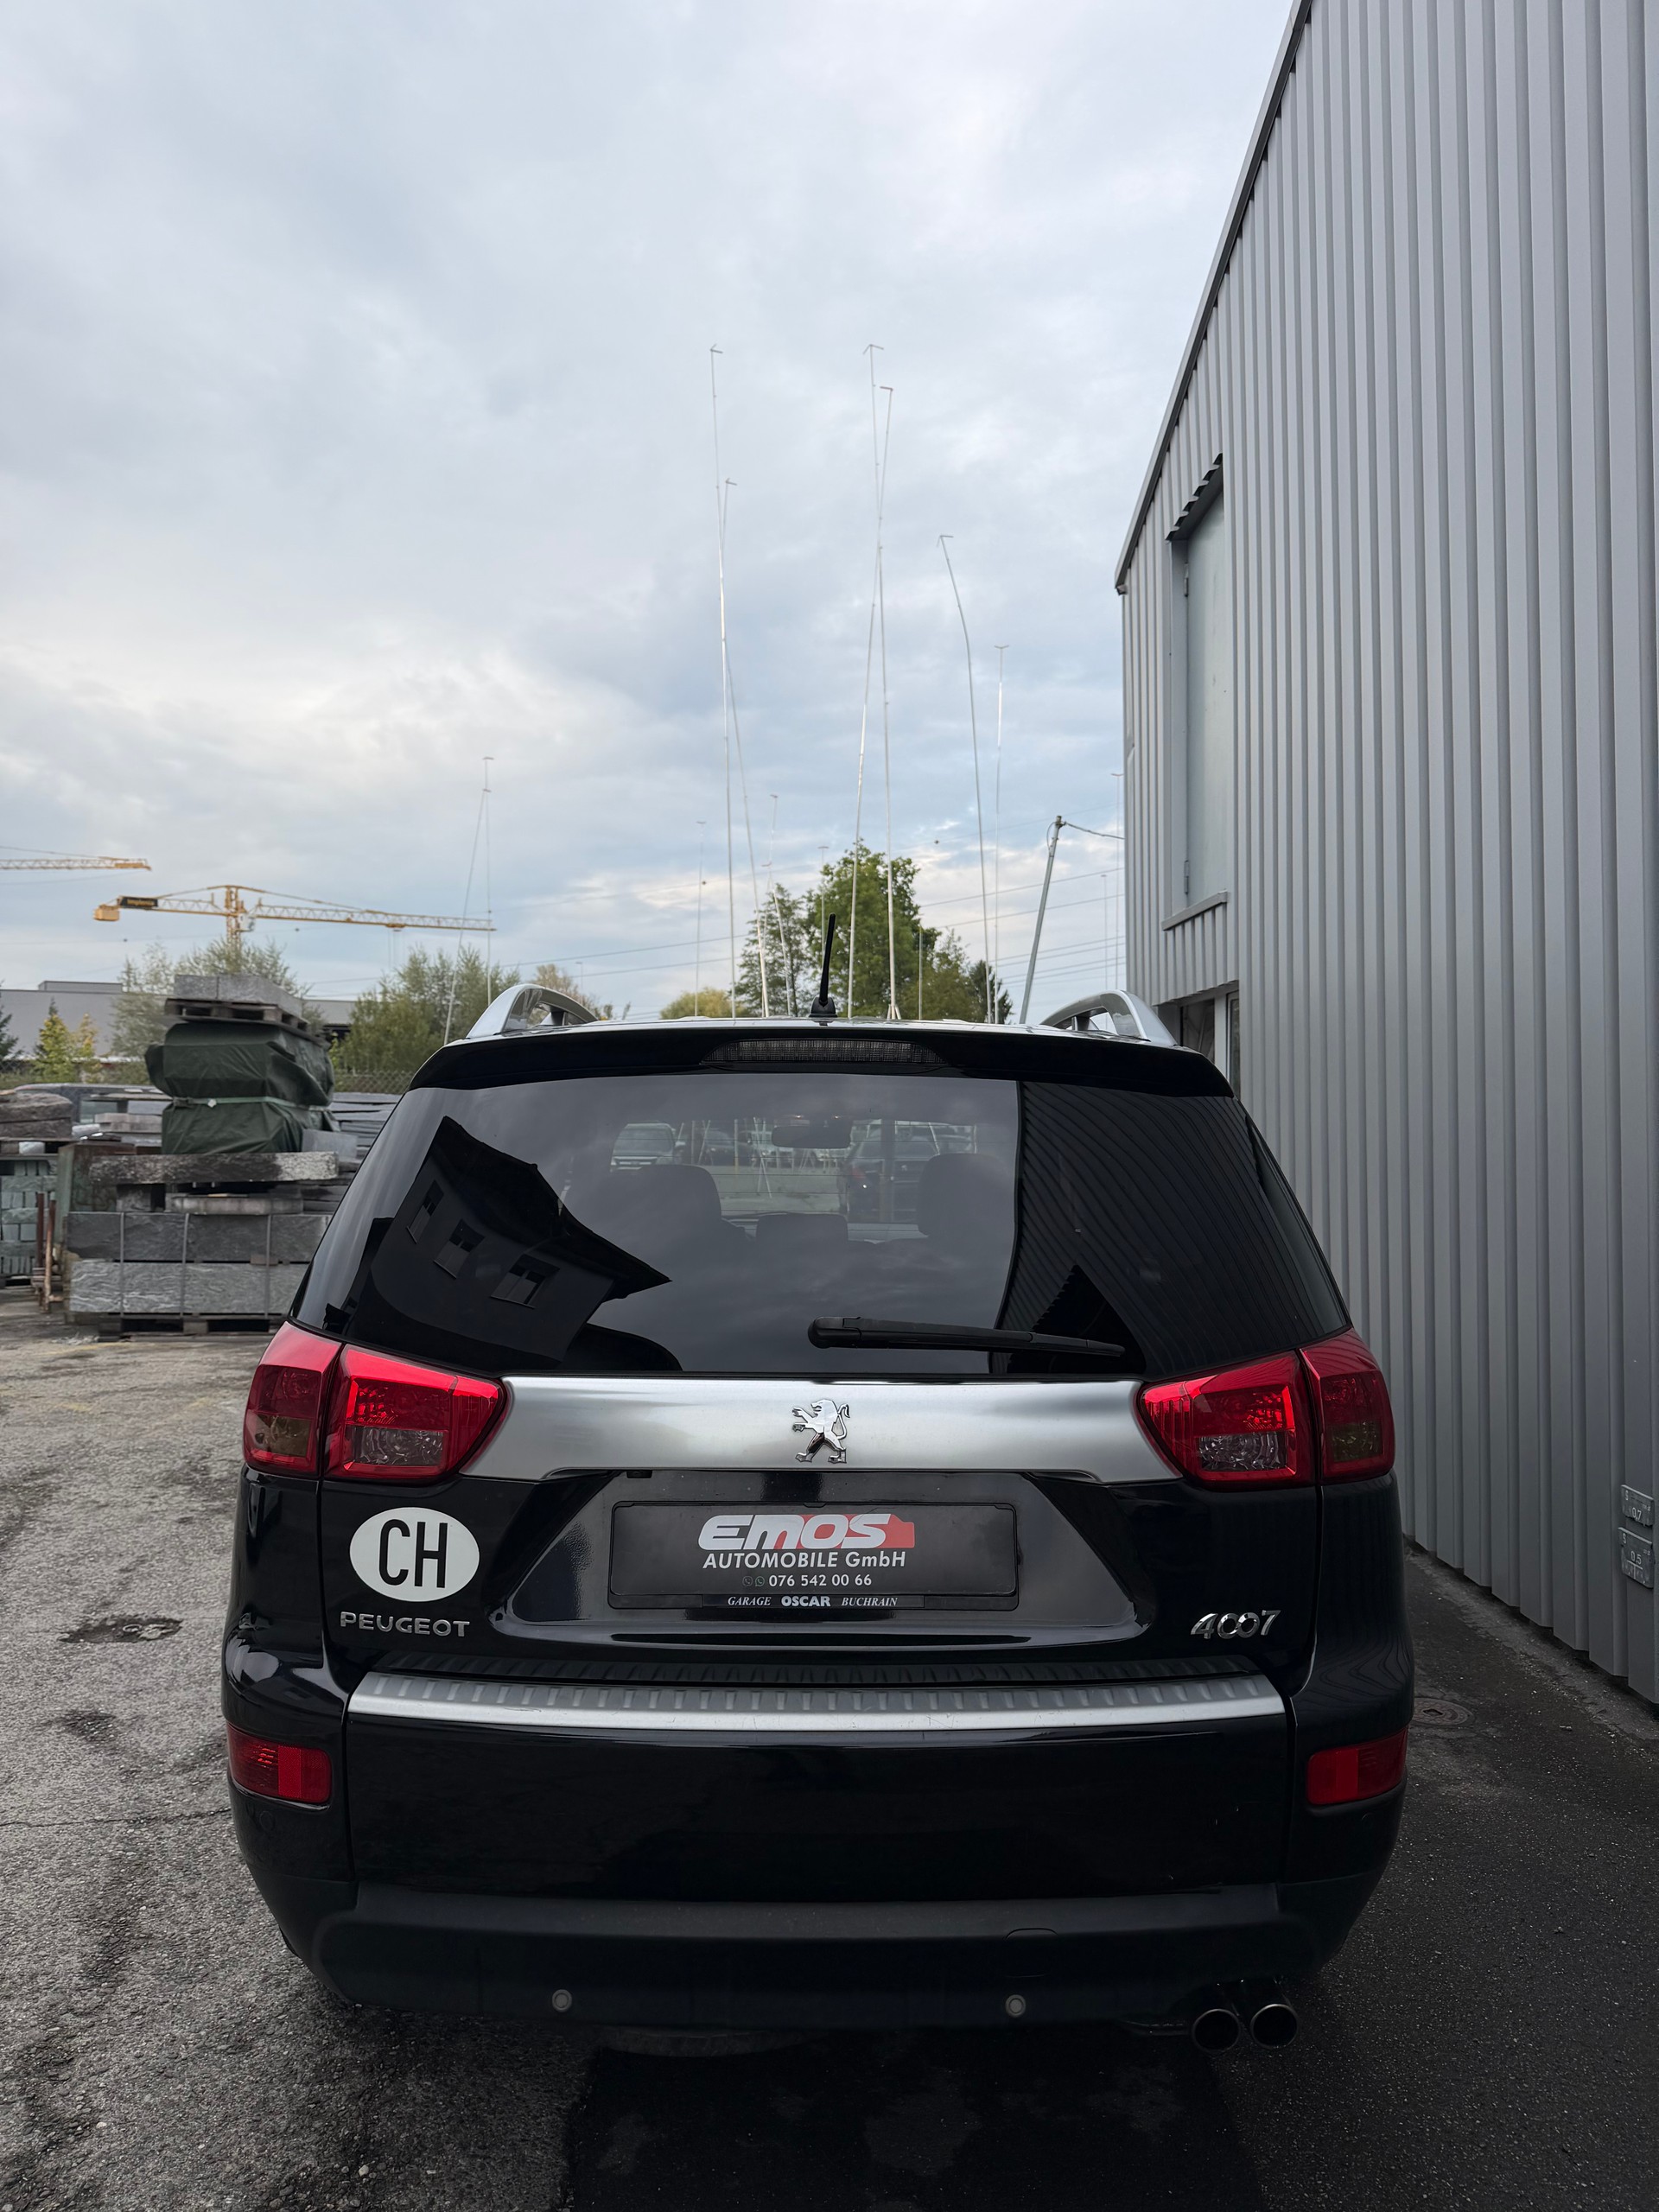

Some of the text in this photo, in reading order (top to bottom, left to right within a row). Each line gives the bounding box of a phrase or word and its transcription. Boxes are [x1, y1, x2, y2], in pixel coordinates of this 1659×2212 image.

[378, 1518, 448, 1589] CH
[702, 1550, 906, 1569] AUTOMOBILE GmbH
[768, 1573, 872, 1587] 076 542 00 66
[728, 1595, 898, 1607] GARAGE OSCAR BUCHRAIN
[340, 1611, 470, 1637] PEUGEOT
[1190, 1609, 1281, 1640] 4007
